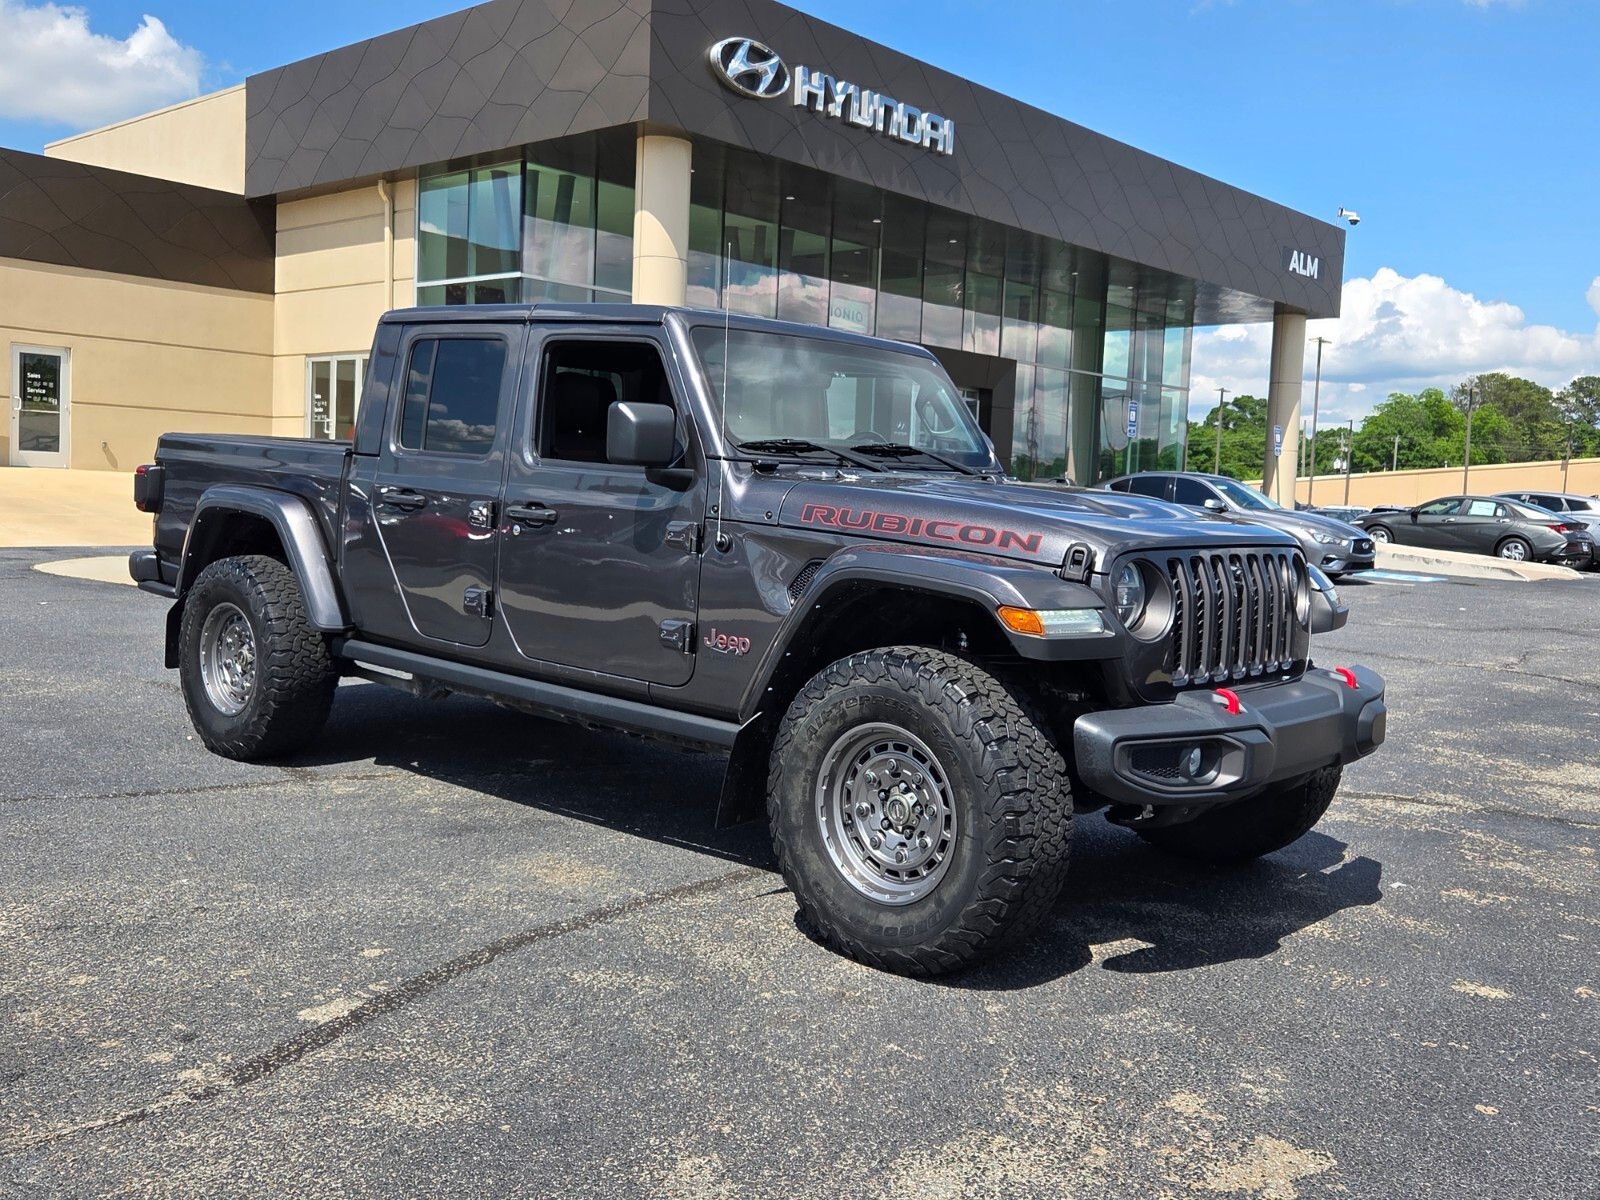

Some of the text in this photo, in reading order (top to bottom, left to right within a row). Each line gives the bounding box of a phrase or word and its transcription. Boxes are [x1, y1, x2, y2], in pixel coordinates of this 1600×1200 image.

[793, 65, 955, 155] HYUNDAI
[1288, 250, 1319, 279] ALM
[801, 503, 1043, 554] RUBICON
[703, 628, 750, 656] Jeep
